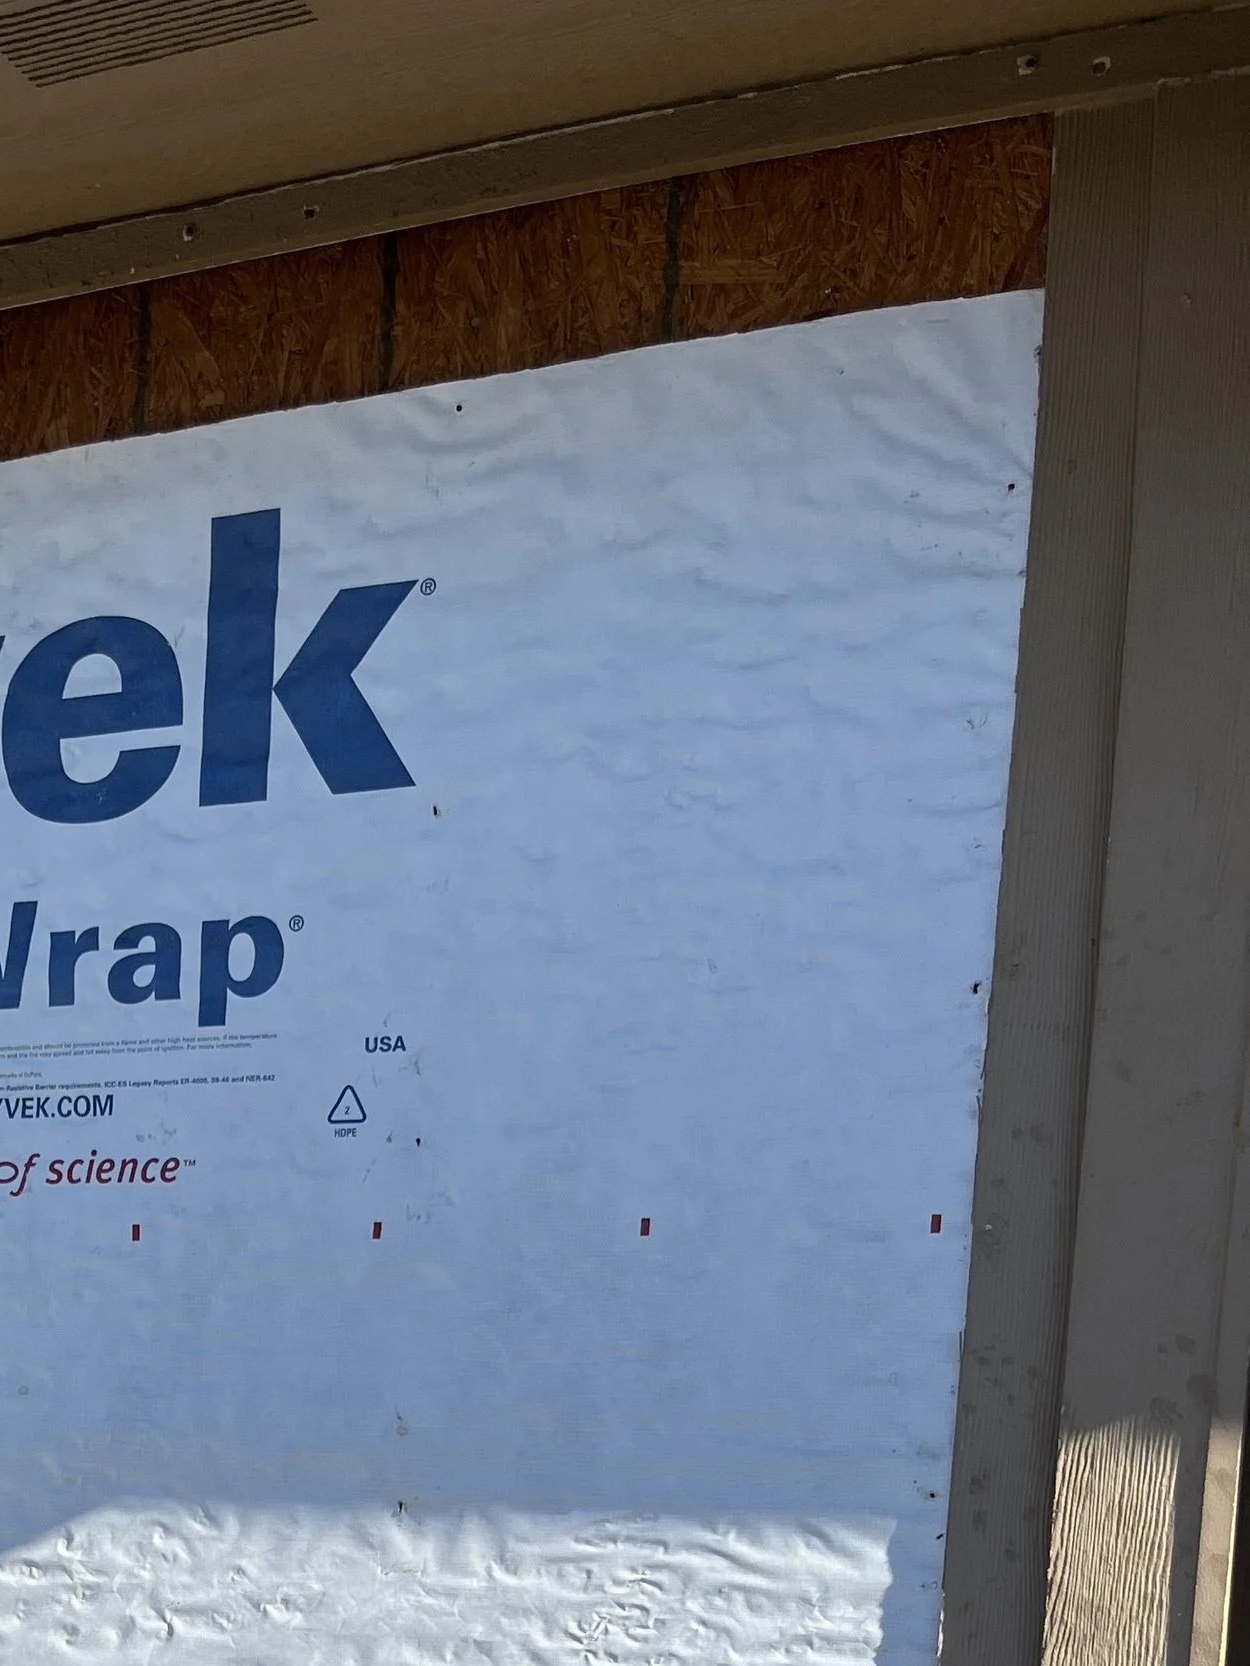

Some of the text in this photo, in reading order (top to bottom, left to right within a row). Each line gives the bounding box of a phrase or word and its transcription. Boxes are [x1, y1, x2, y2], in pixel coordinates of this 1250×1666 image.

[365, 1035, 406, 1053] USA
[344, 1106, 350, 1115] 2
[334, 1128, 357, 1138] HDPE
